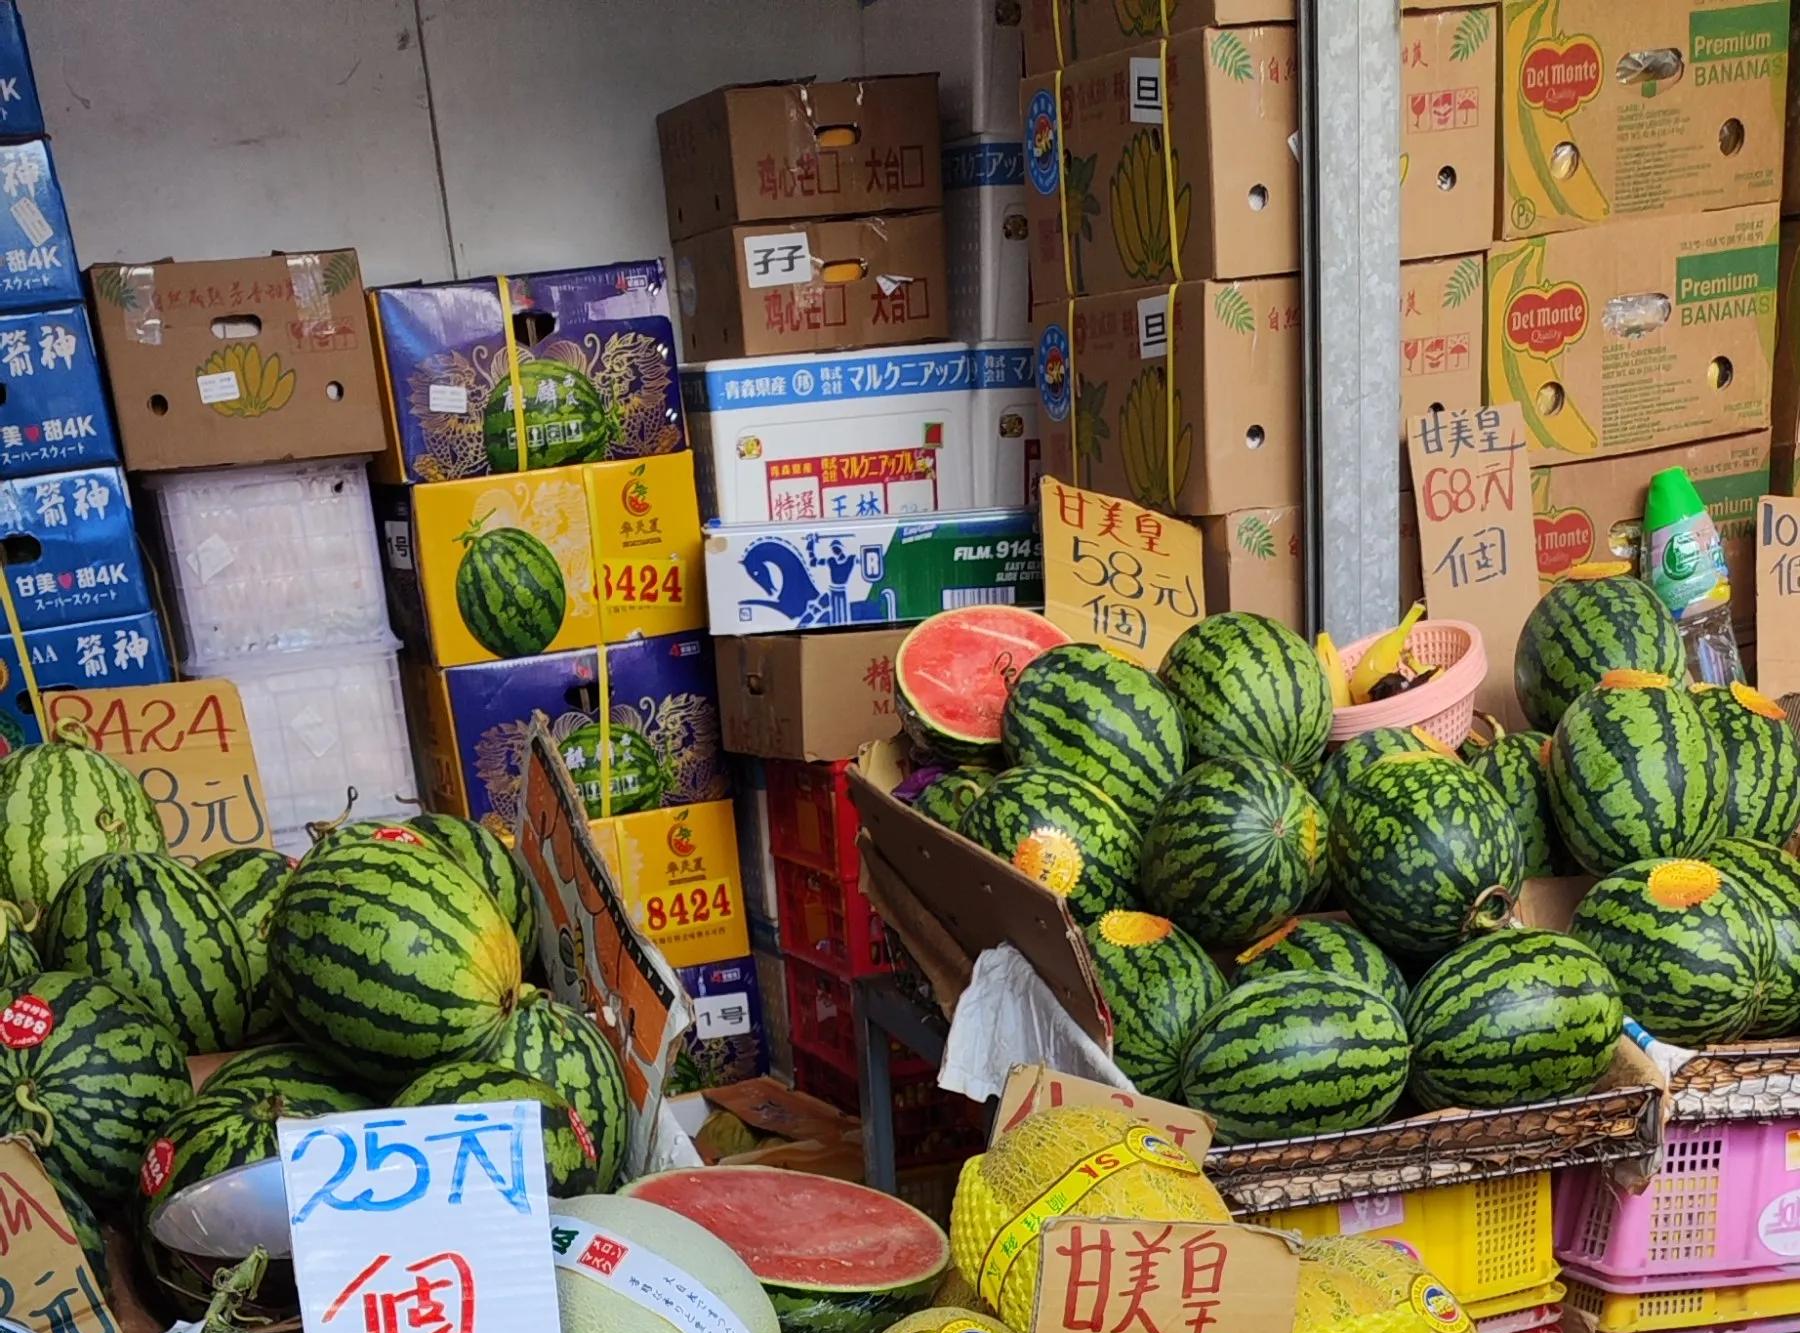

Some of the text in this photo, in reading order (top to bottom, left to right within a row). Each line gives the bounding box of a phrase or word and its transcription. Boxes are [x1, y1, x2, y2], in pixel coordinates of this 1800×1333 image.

[1695, 31, 1771, 58] Premium
[0, 78, 22, 101] K
[1526, 62, 1597, 89] Del Monte
[1694, 55, 1784, 87] BANANAS
[1681, 272, 1759, 298] Premium
[1511, 306, 1583, 331] Del Monte
[1681, 292, 1771, 326] BANANAS
[1414, 406, 1527, 458] 甘美皇
[35, 476, 110, 528] 箭神
[1054, 485, 1171, 558] 甘美皇
[996, 539, 1032, 559] 914
[1434, 527, 1507, 588] 個
[1545, 528, 1589, 548] Monte
[593, 563, 683, 602] 8424
[1072, 536, 1200, 618] 58元
[1082, 594, 1147, 649] 個
[75, 629, 150, 678] 箭神
[49, 694, 236, 756] 8424
[647, 883, 732, 932] 8424
[291, 1103, 532, 1224] 25元
